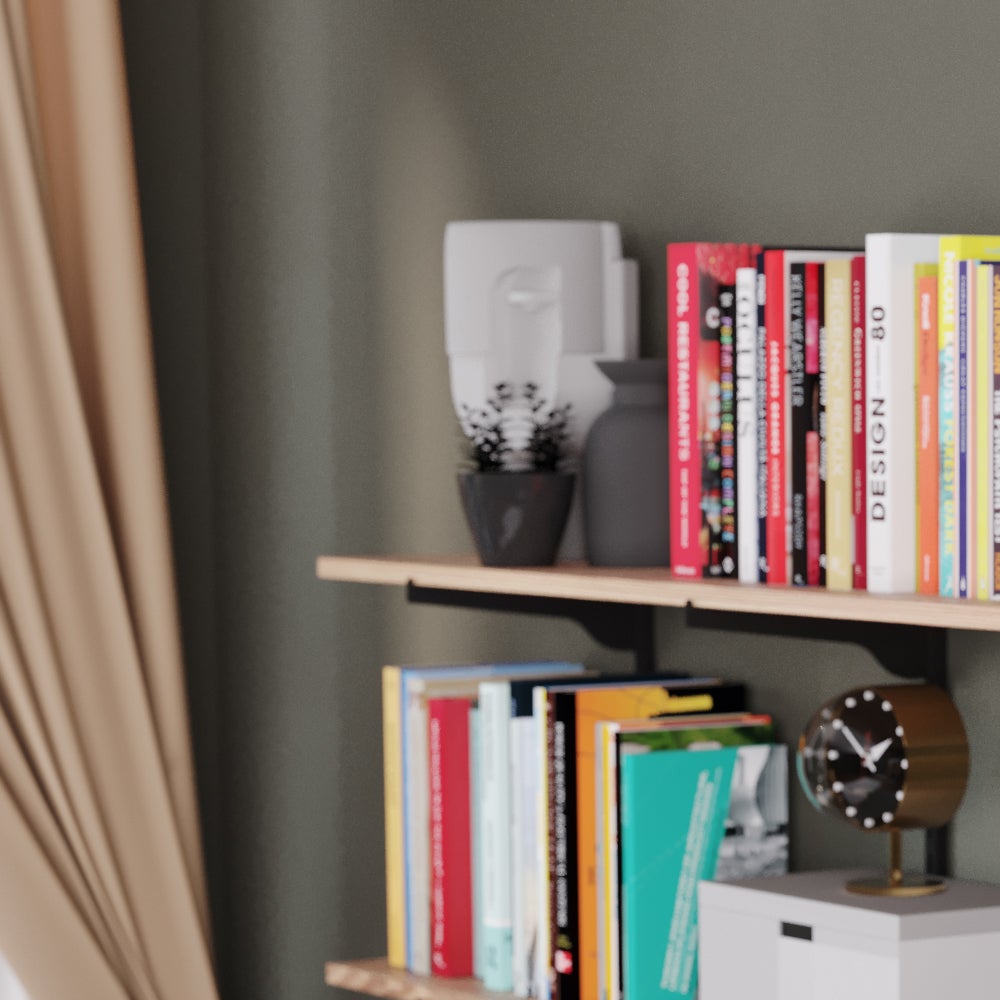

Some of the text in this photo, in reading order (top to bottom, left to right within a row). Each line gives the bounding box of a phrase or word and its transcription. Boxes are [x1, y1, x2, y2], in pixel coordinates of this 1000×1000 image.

[677, 263, 691, 462] COOL RESTAURANTS
[945, 252, 956, 325] NICOLE
[872, 306, 885, 522] DESIGN 80
